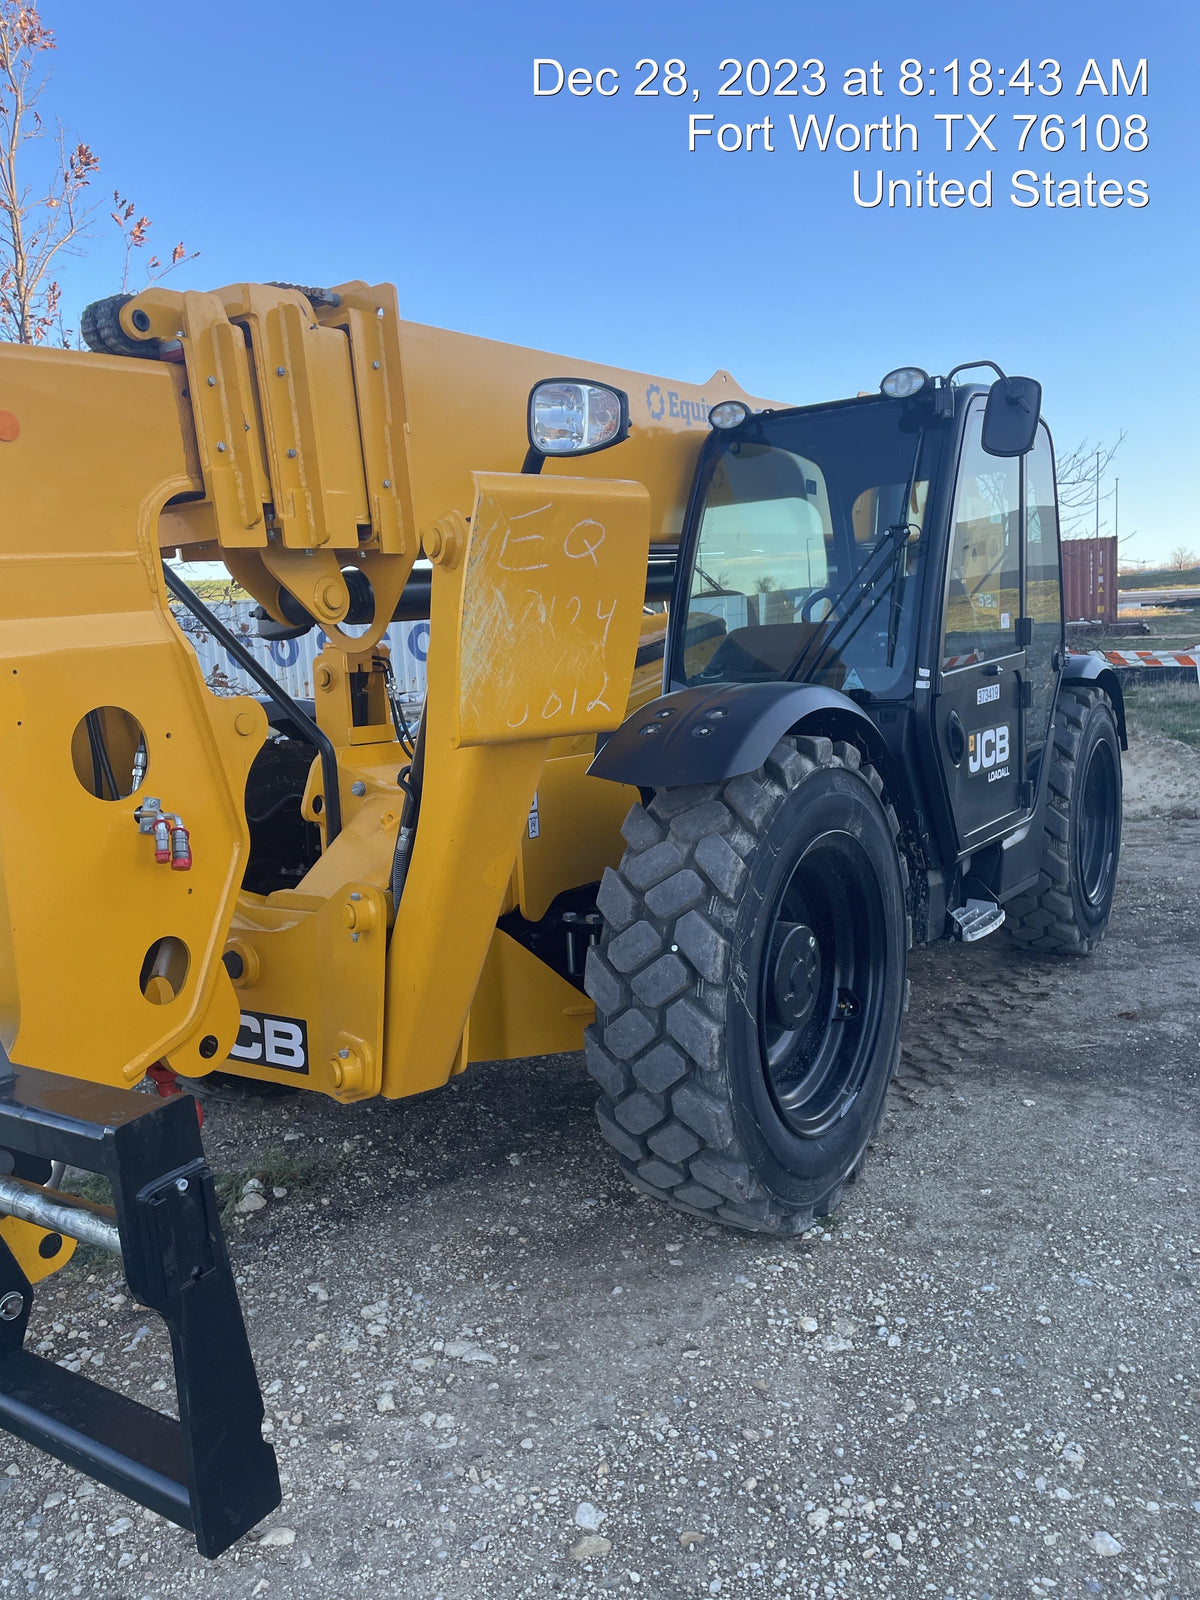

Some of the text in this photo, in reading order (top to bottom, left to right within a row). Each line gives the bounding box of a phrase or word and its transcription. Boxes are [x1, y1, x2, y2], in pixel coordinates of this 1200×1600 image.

[668, 391, 713, 428] Equi
[968, 725, 1010, 773] JCB
[987, 766, 1010, 783] LOADALL
[230, 1013, 305, 1068] CB
